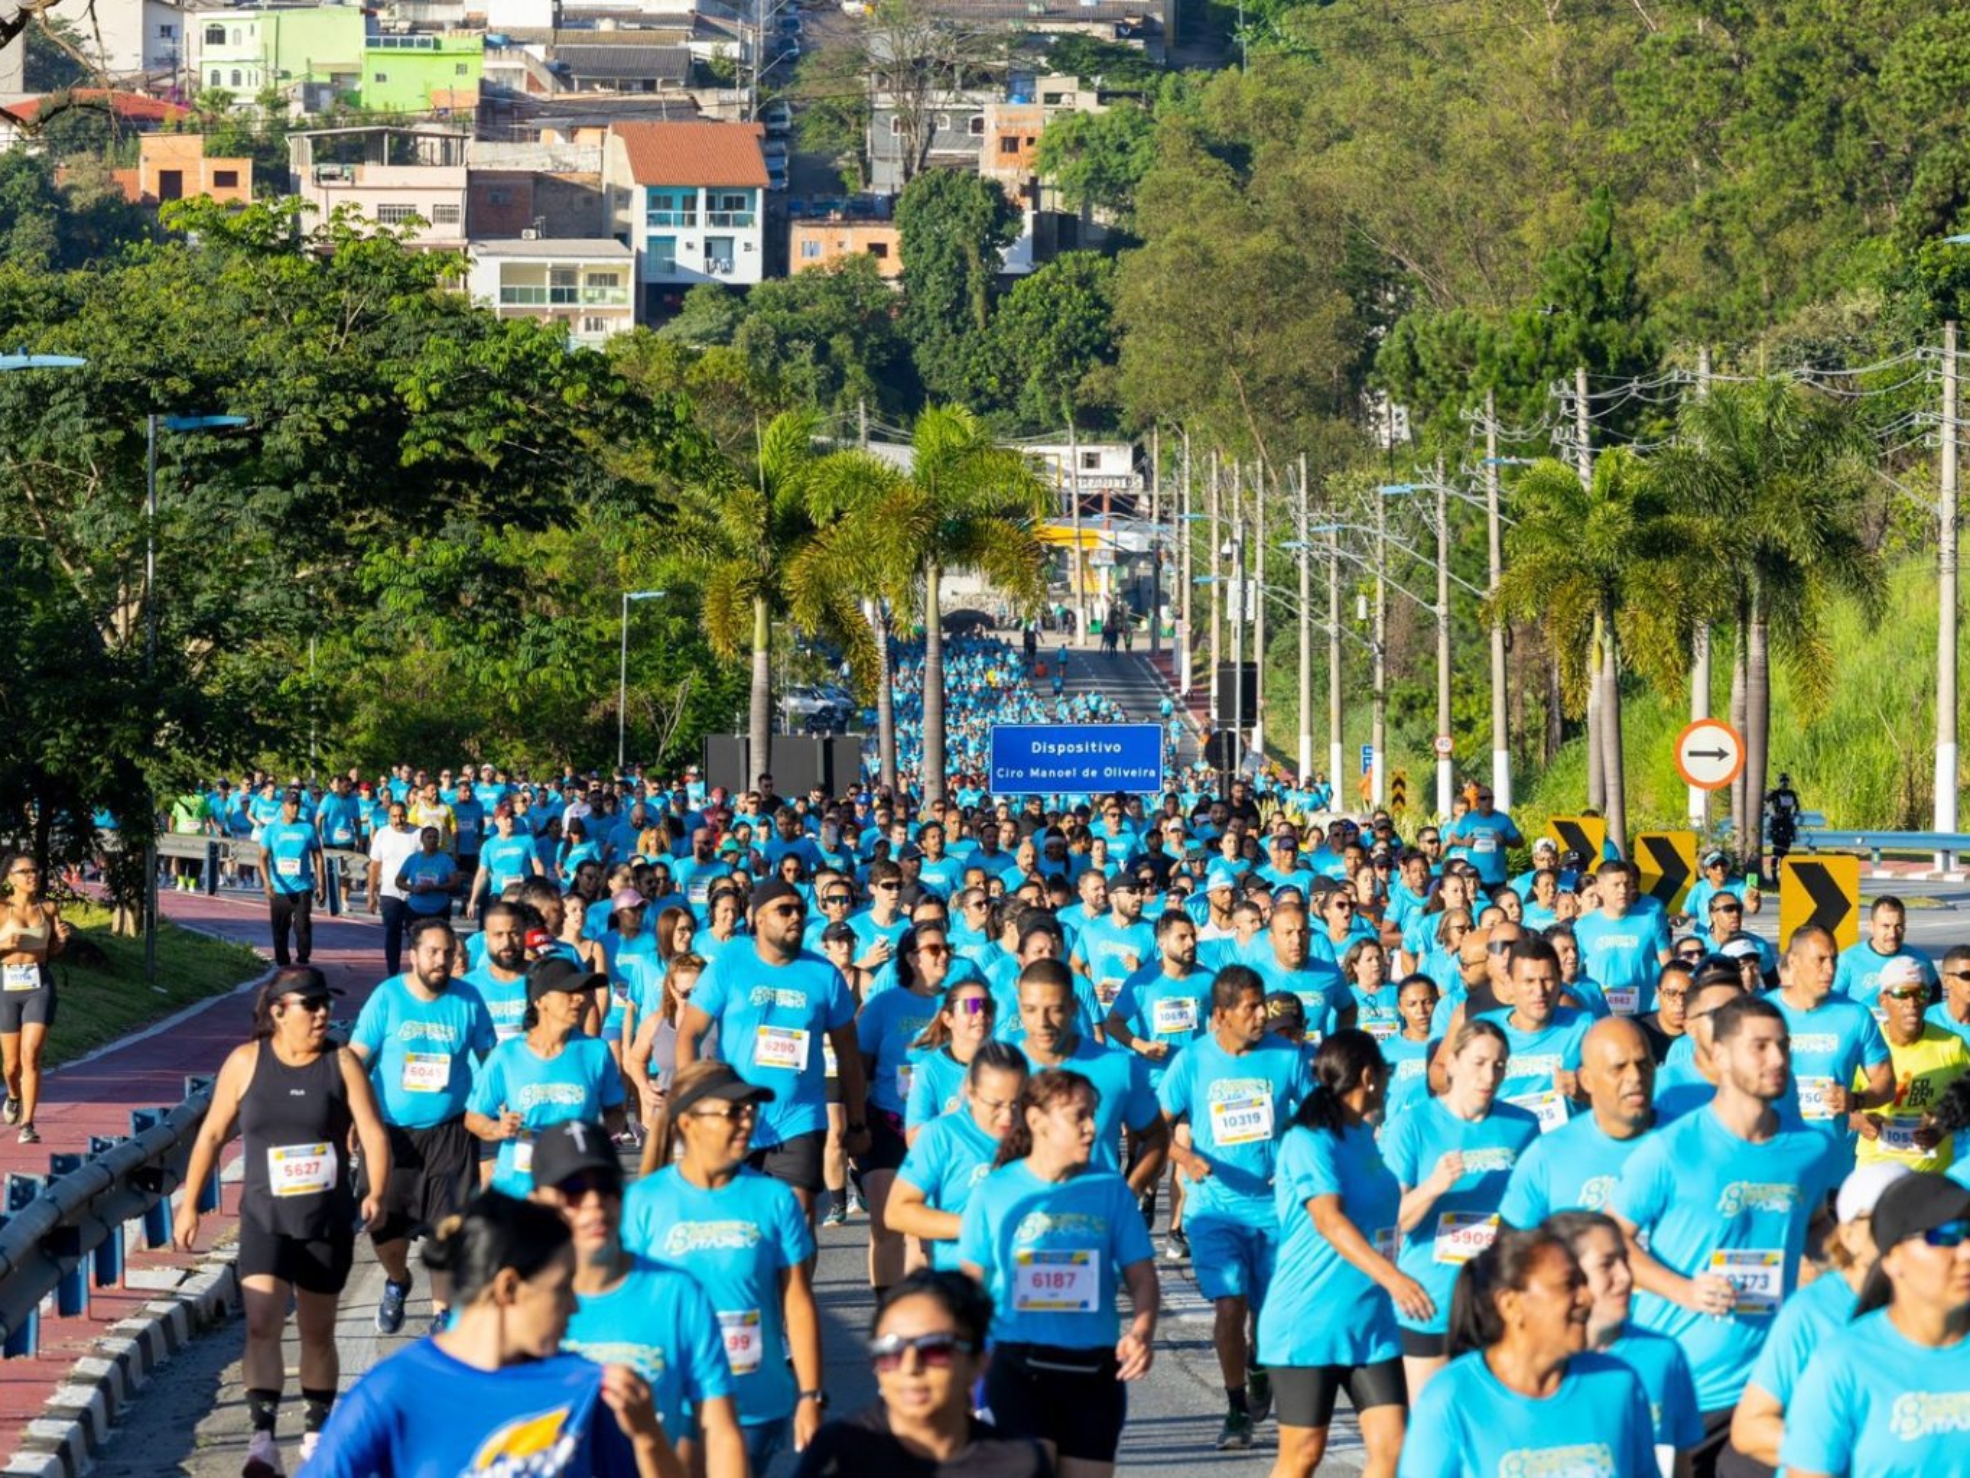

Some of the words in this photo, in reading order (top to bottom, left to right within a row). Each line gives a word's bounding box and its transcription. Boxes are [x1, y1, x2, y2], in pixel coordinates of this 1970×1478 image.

[1031, 740, 1122, 757] Dispositivo
[996, 767, 1024, 779] Ciro
[1030, 766, 1077, 778] Manoel
[1082, 767, 1097, 778] de
[1104, 766, 1156, 778] Oliveira
[1222, 1111, 1262, 1129] 10319
[284, 1161, 321, 1177] 5627
[1031, 1272, 1076, 1289] 6187
